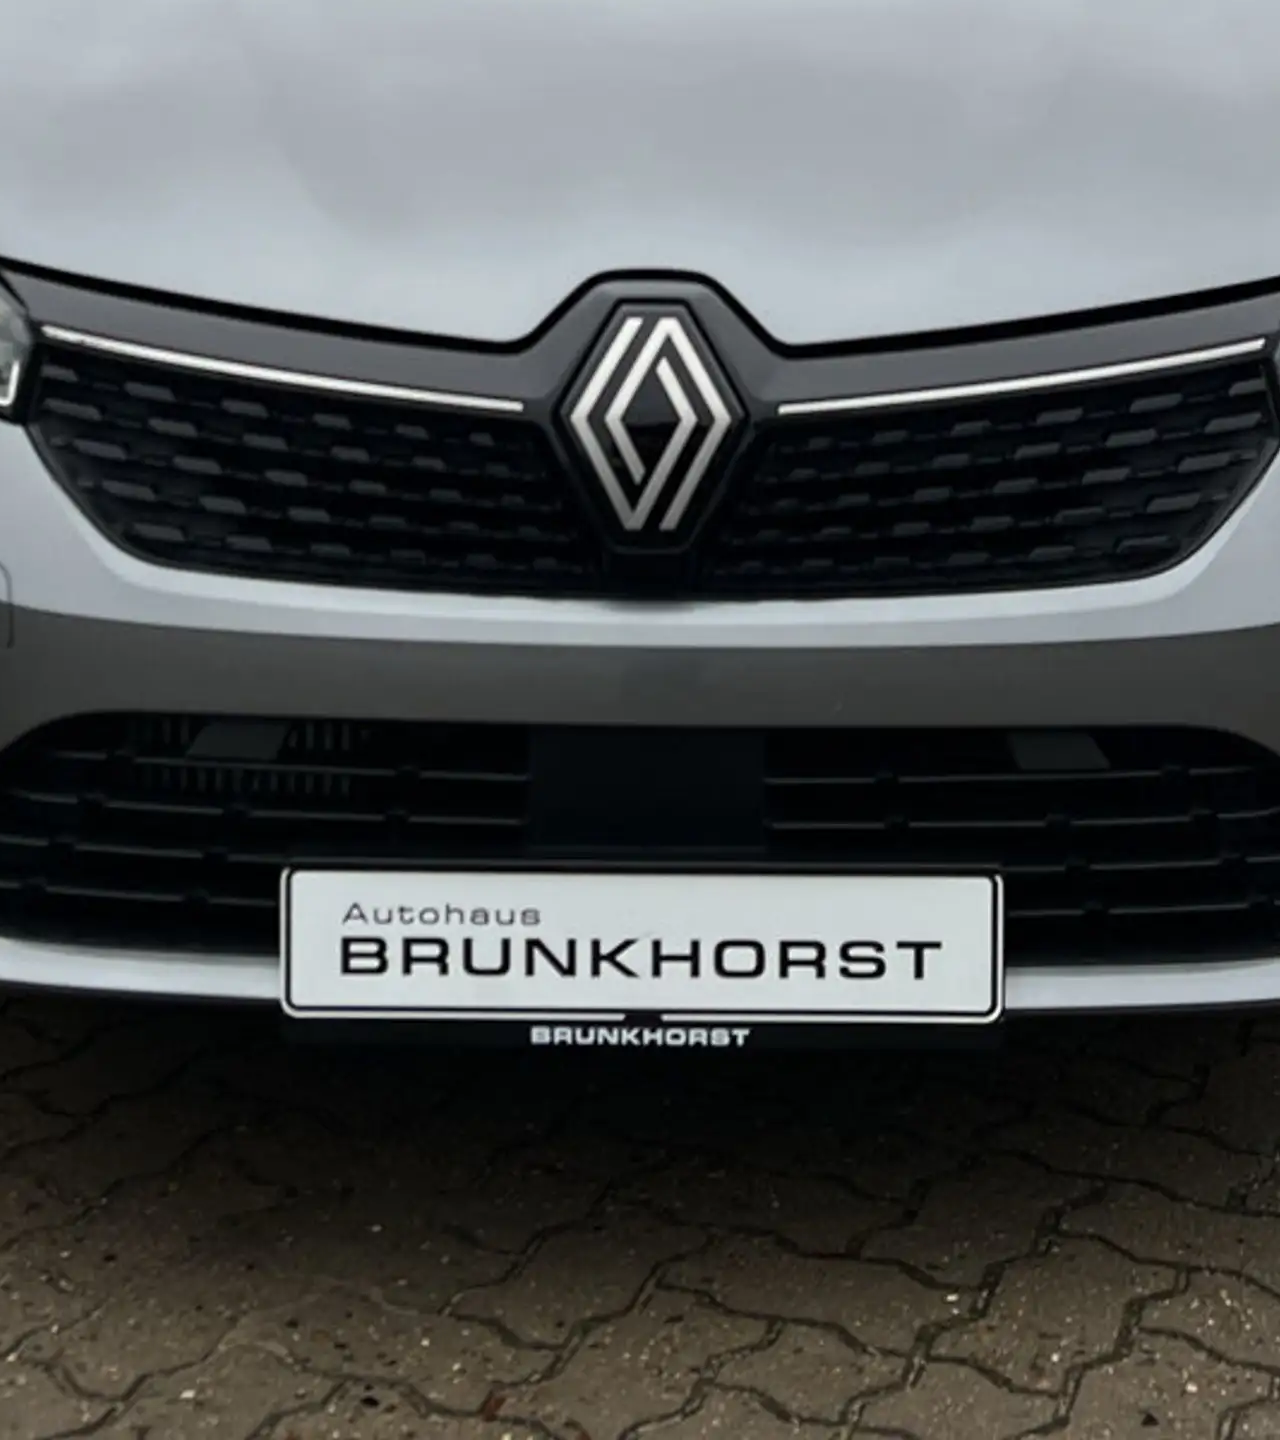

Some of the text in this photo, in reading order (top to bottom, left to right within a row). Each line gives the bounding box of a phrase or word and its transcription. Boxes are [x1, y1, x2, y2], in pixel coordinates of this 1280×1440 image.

[342, 902, 541, 925] Autohaus
[340, 936, 943, 980] BRUNKHORST
[530, 1026, 750, 1046] BRUNKHORST
